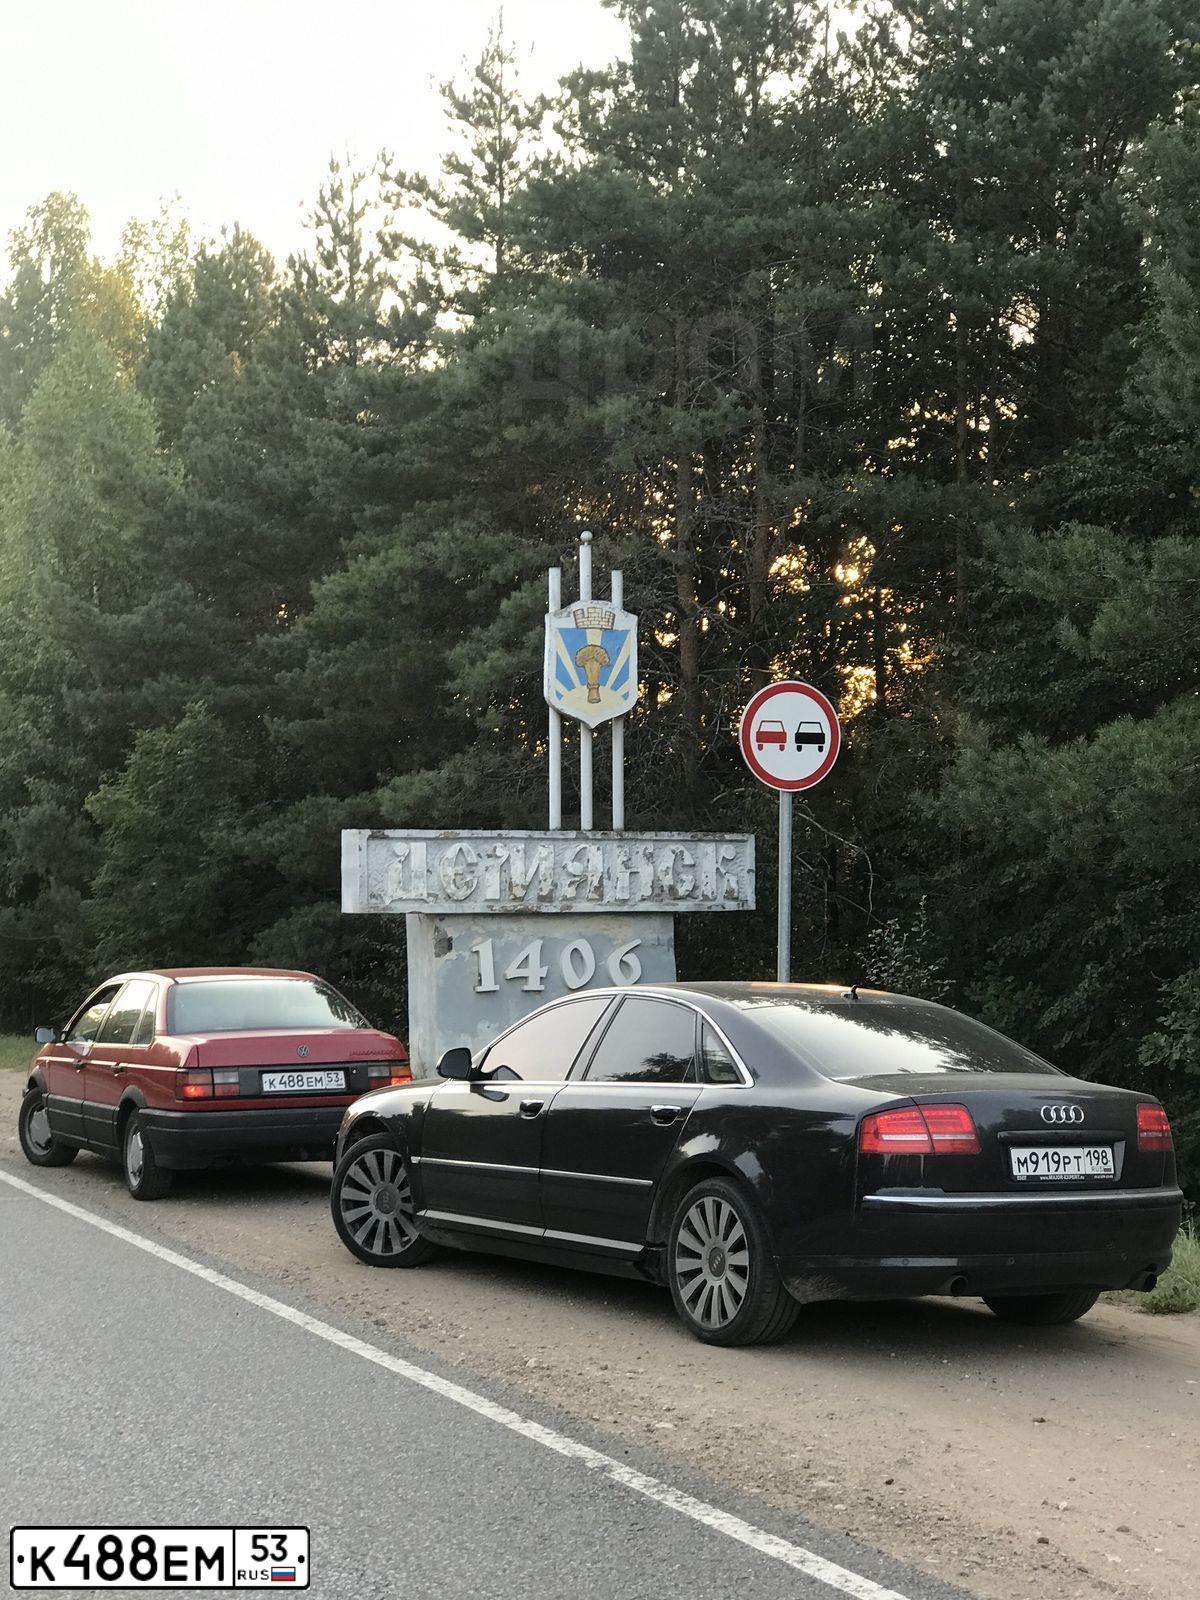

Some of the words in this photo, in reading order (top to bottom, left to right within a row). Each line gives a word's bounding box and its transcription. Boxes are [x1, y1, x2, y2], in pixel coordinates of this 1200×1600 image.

[471, 938, 642, 993] 1406
[326, 1072, 340, 1084] 53
[1086, 1150, 1108, 1166] 198
